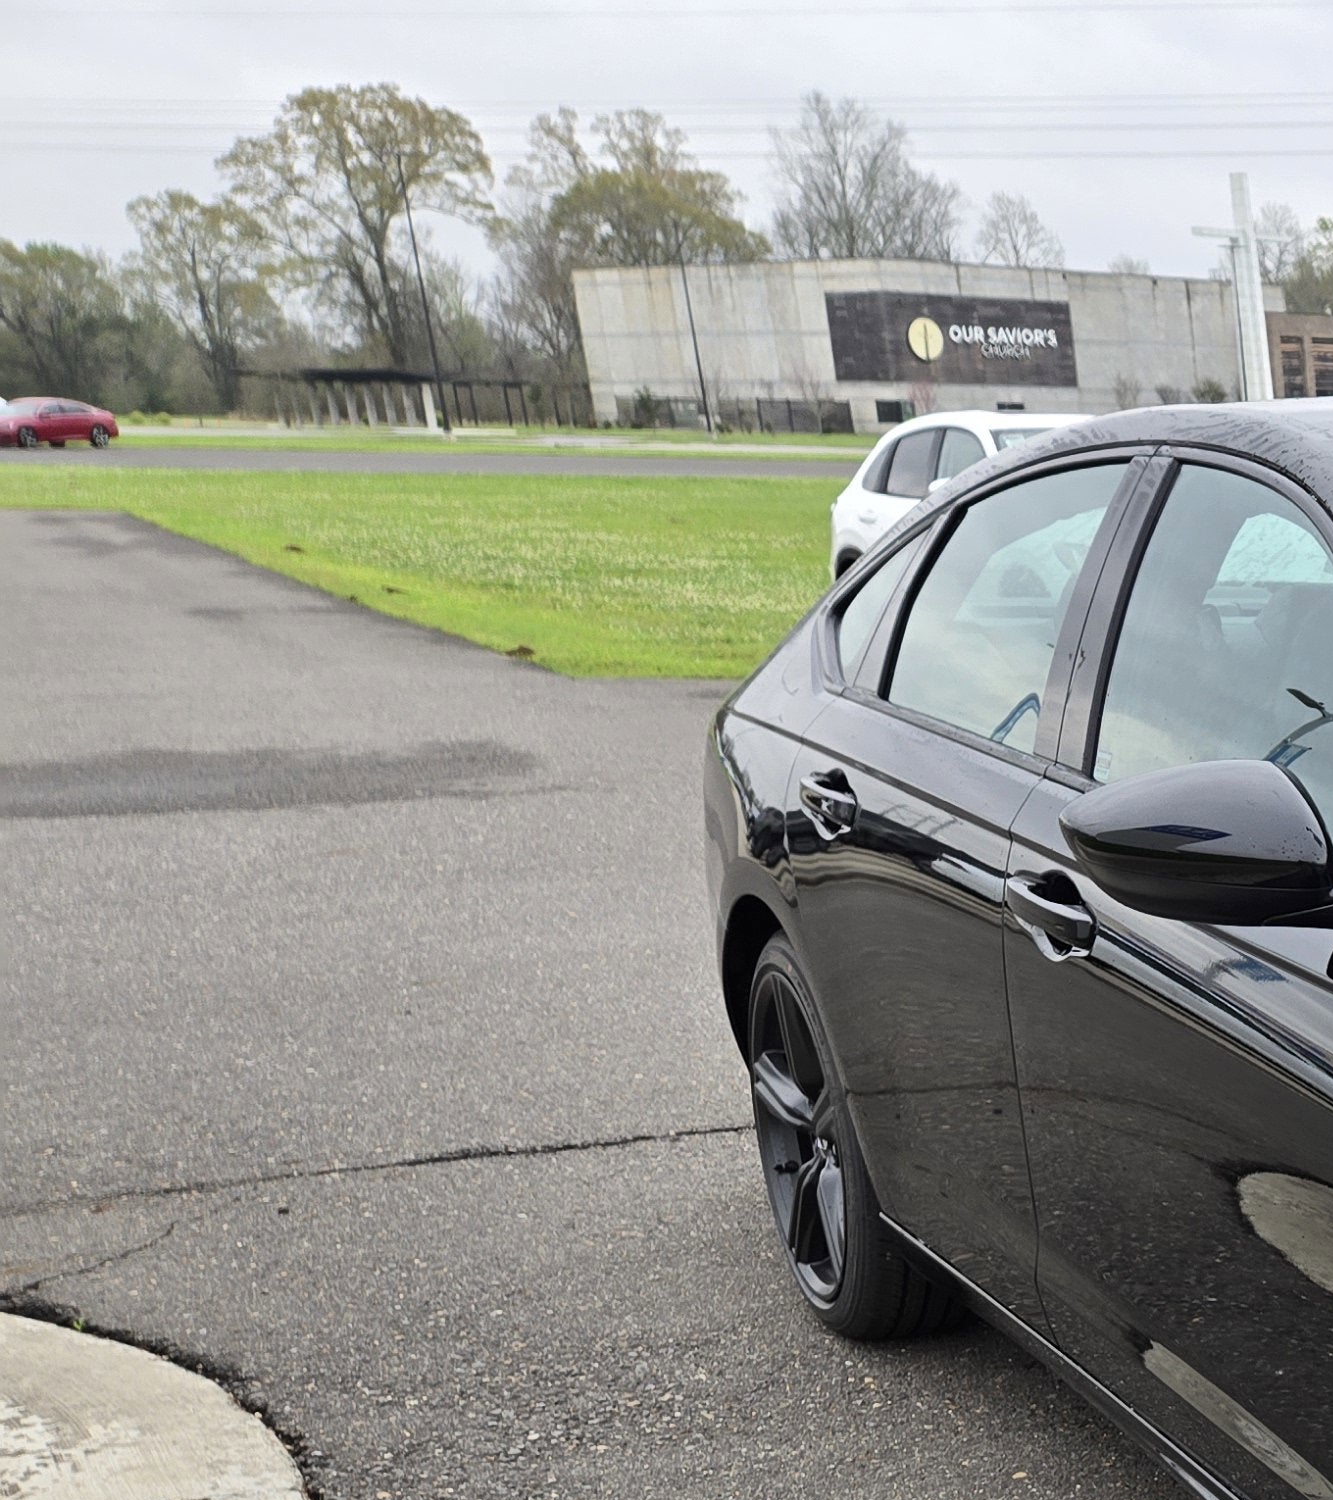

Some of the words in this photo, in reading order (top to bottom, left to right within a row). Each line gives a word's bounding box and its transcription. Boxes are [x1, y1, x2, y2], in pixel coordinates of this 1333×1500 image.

[949, 324, 986, 345] OUR
[987, 326, 1058, 348] SAVIOR'S
[981, 342, 1031, 360] CHURCH
